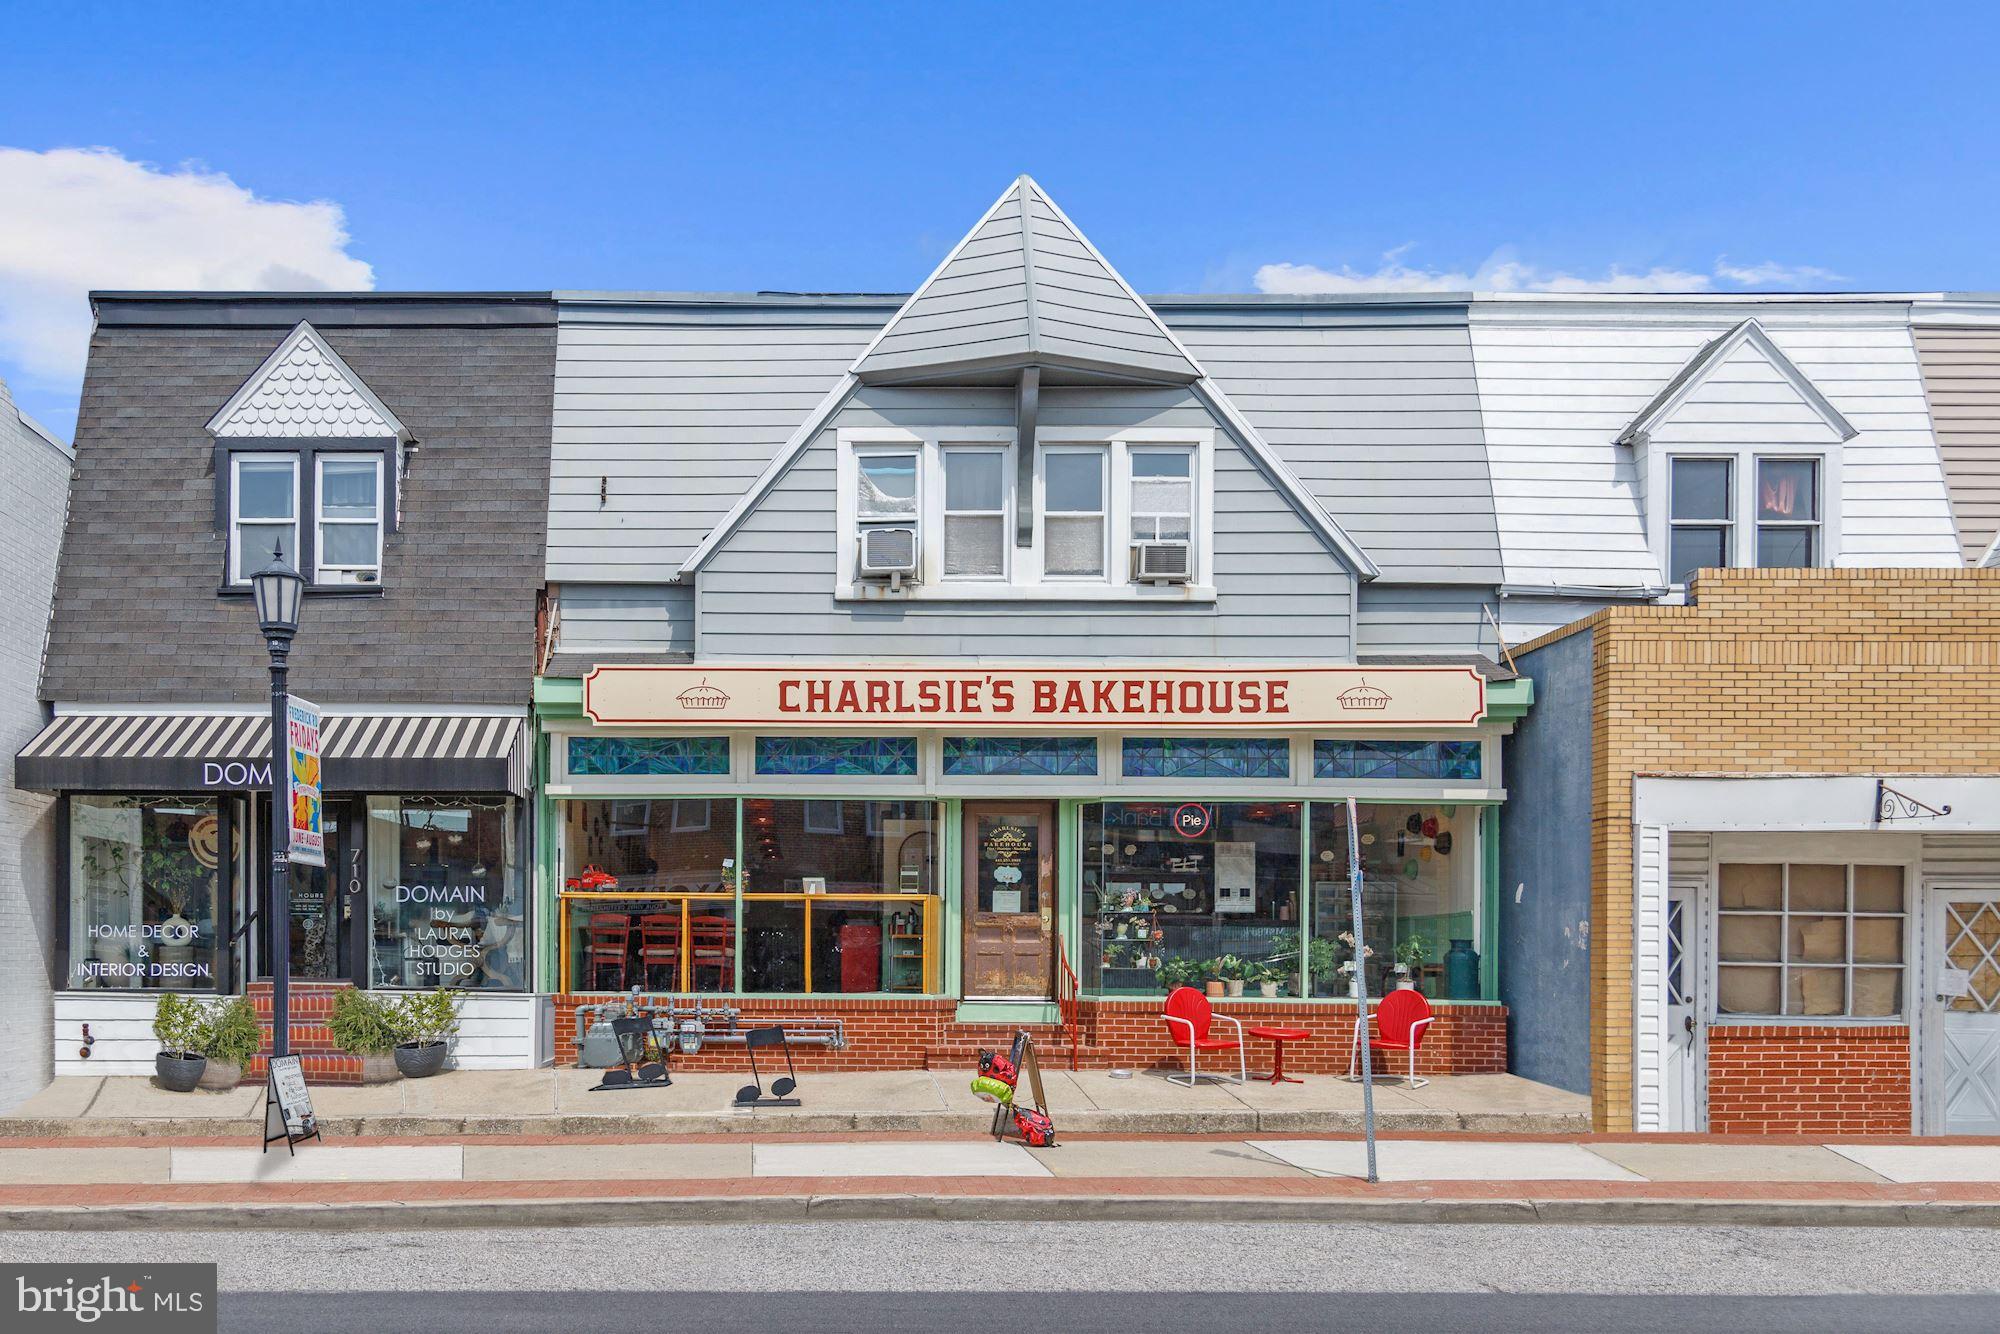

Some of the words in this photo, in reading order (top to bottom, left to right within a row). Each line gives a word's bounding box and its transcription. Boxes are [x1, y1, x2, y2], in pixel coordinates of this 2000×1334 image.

[778, 676, 1015, 713] CHARLSIE'S
[1032, 680, 1290, 714] BAKEHOUSE
[290, 721, 318, 753] FRIDAYS
[204, 762, 273, 785] DOM
[1182, 814, 1202, 827] Pie
[990, 825, 1026, 838] CHARLSIE'S
[350, 848, 361, 893] 710
[395, 885, 485, 903] DOMAIN
[435, 907, 455, 923] by
[88, 925, 136, 938] HOME
[141, 925, 199, 938] DECOR
[418, 927, 472, 940] LAURA
[138, 945, 149, 958] &
[410, 944, 480, 958] HODGES
[77, 963, 146, 977] INTERIOR
[151, 963, 209, 977] DESIGN
[416, 962, 475, 976] STUDIO
